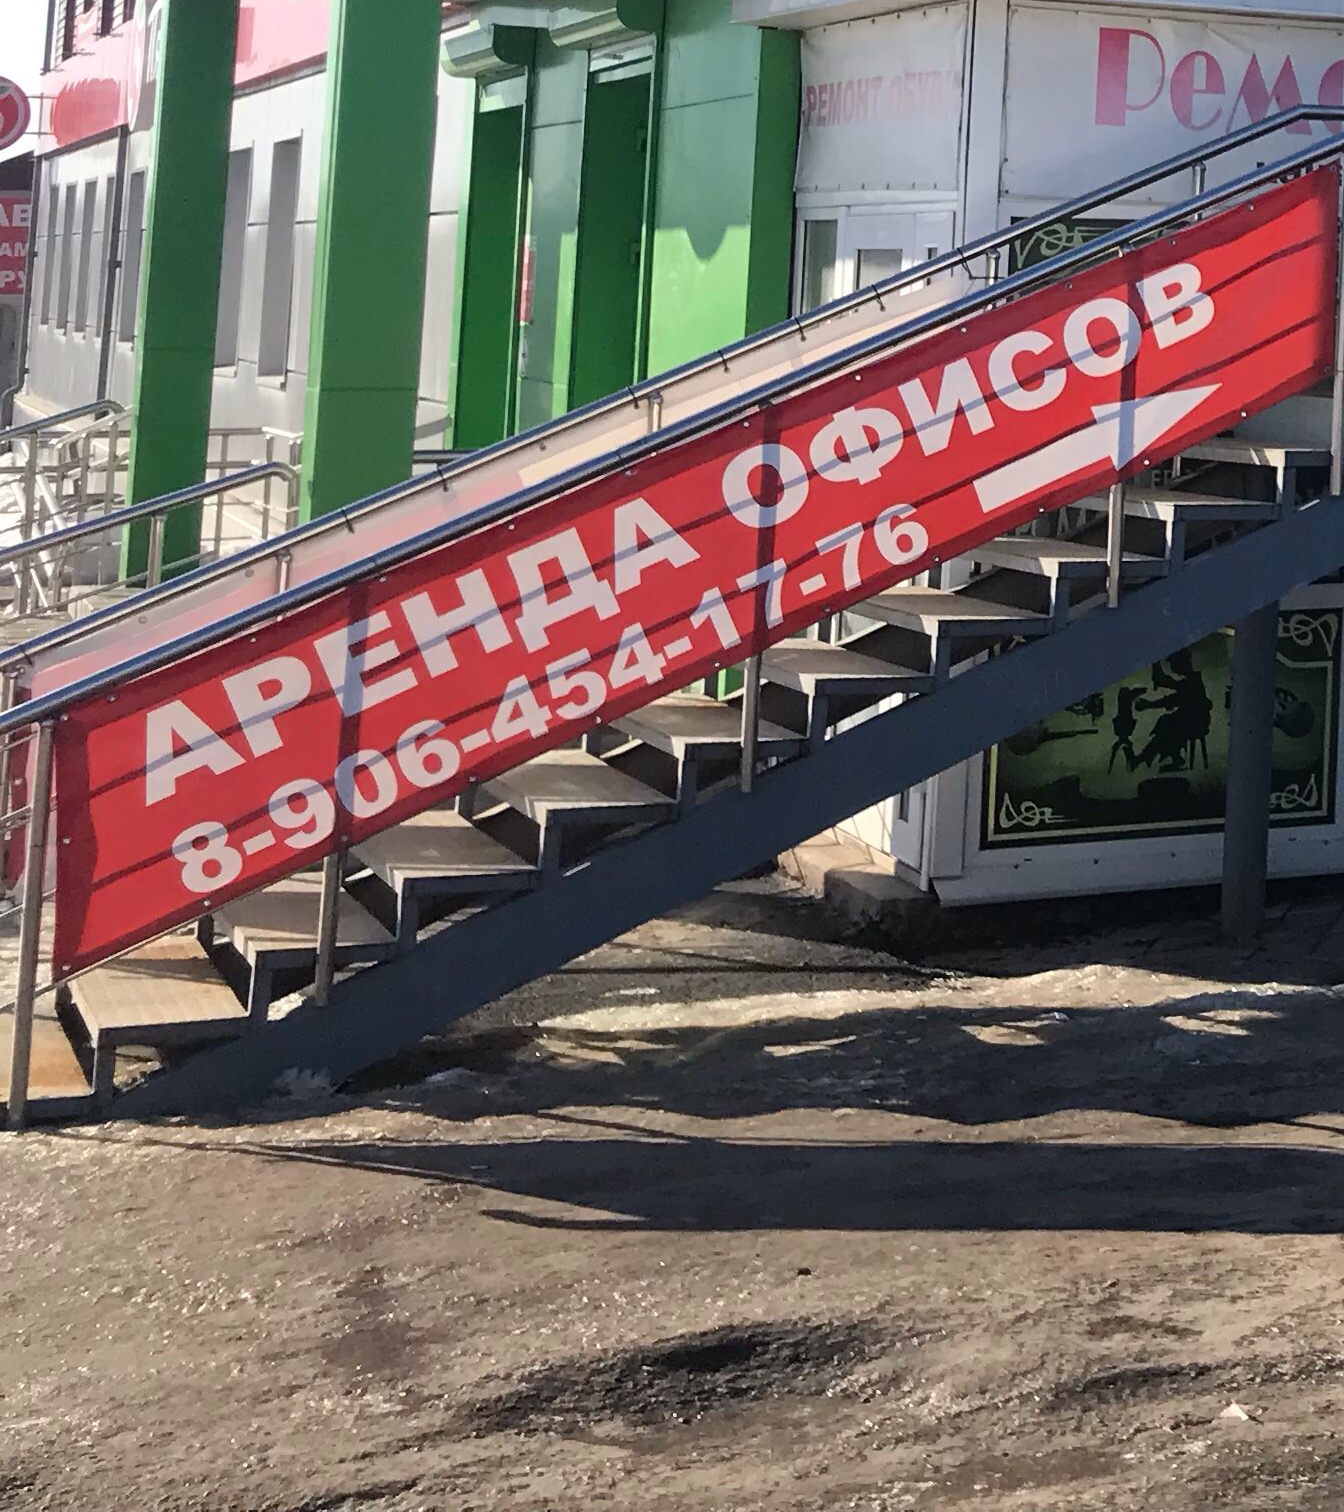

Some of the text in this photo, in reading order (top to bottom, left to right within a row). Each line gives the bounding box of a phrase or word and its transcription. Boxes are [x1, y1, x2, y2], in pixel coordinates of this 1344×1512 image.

[806, 76, 883, 127] РЕМОНТ
[145, 260, 1217, 805] АРЕНДА ОФИСОВ
[172, 503, 931, 895] 8-906-454-17-76
